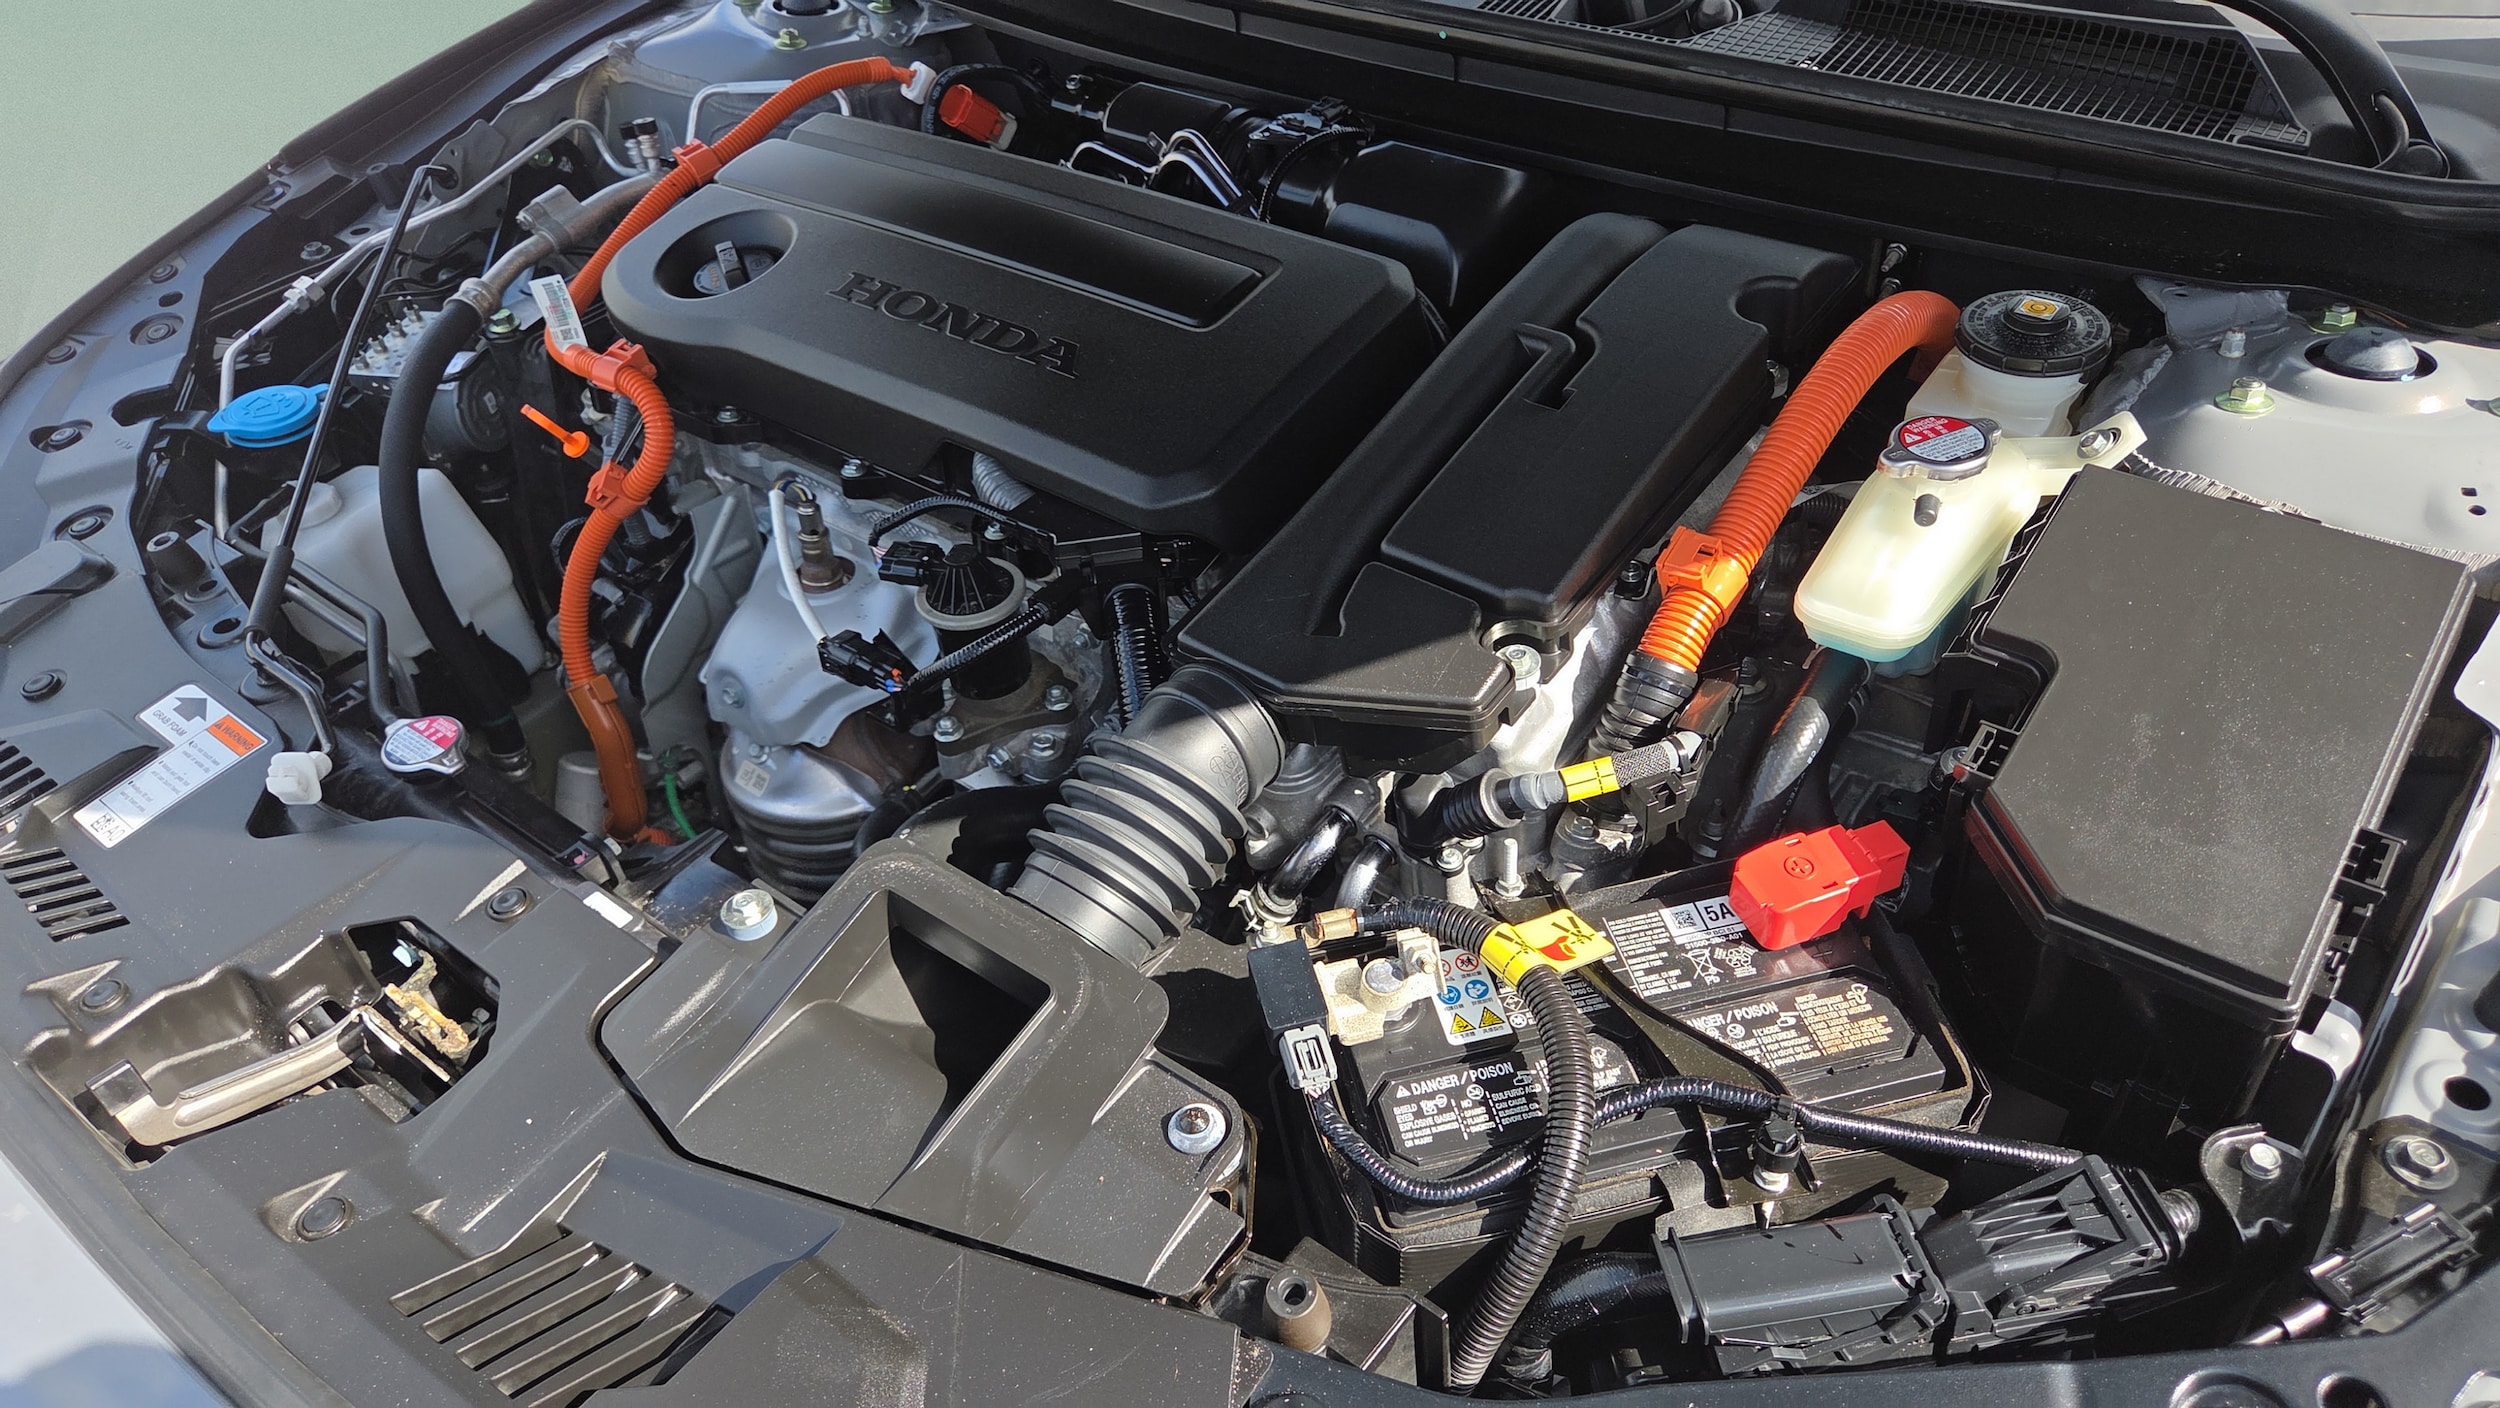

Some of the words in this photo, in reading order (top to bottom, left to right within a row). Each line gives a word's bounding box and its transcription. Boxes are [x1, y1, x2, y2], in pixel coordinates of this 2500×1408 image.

[826, 272, 1080, 379] HONDA
[153, 710, 169, 724] GRAB
[168, 721, 188, 737] FOAM
[224, 722, 254, 751] WARNING
[1704, 975, 1720, 986] Pb
[1687, 1014, 1725, 1031] ANGER
[1734, 1001, 1779, 1021] POISON
[1411, 1074, 1460, 1096] DANGER
[1470, 1062, 1514, 1082] POISON
[1492, 1088, 1525, 1101] SULFURIC
[1525, 1083, 1542, 1094] ACID
[1393, 1104, 1418, 1115] SHIELD
[1461, 1099, 1473, 1109] NO
[1399, 1117, 1435, 1132] EXPLOSIVE
